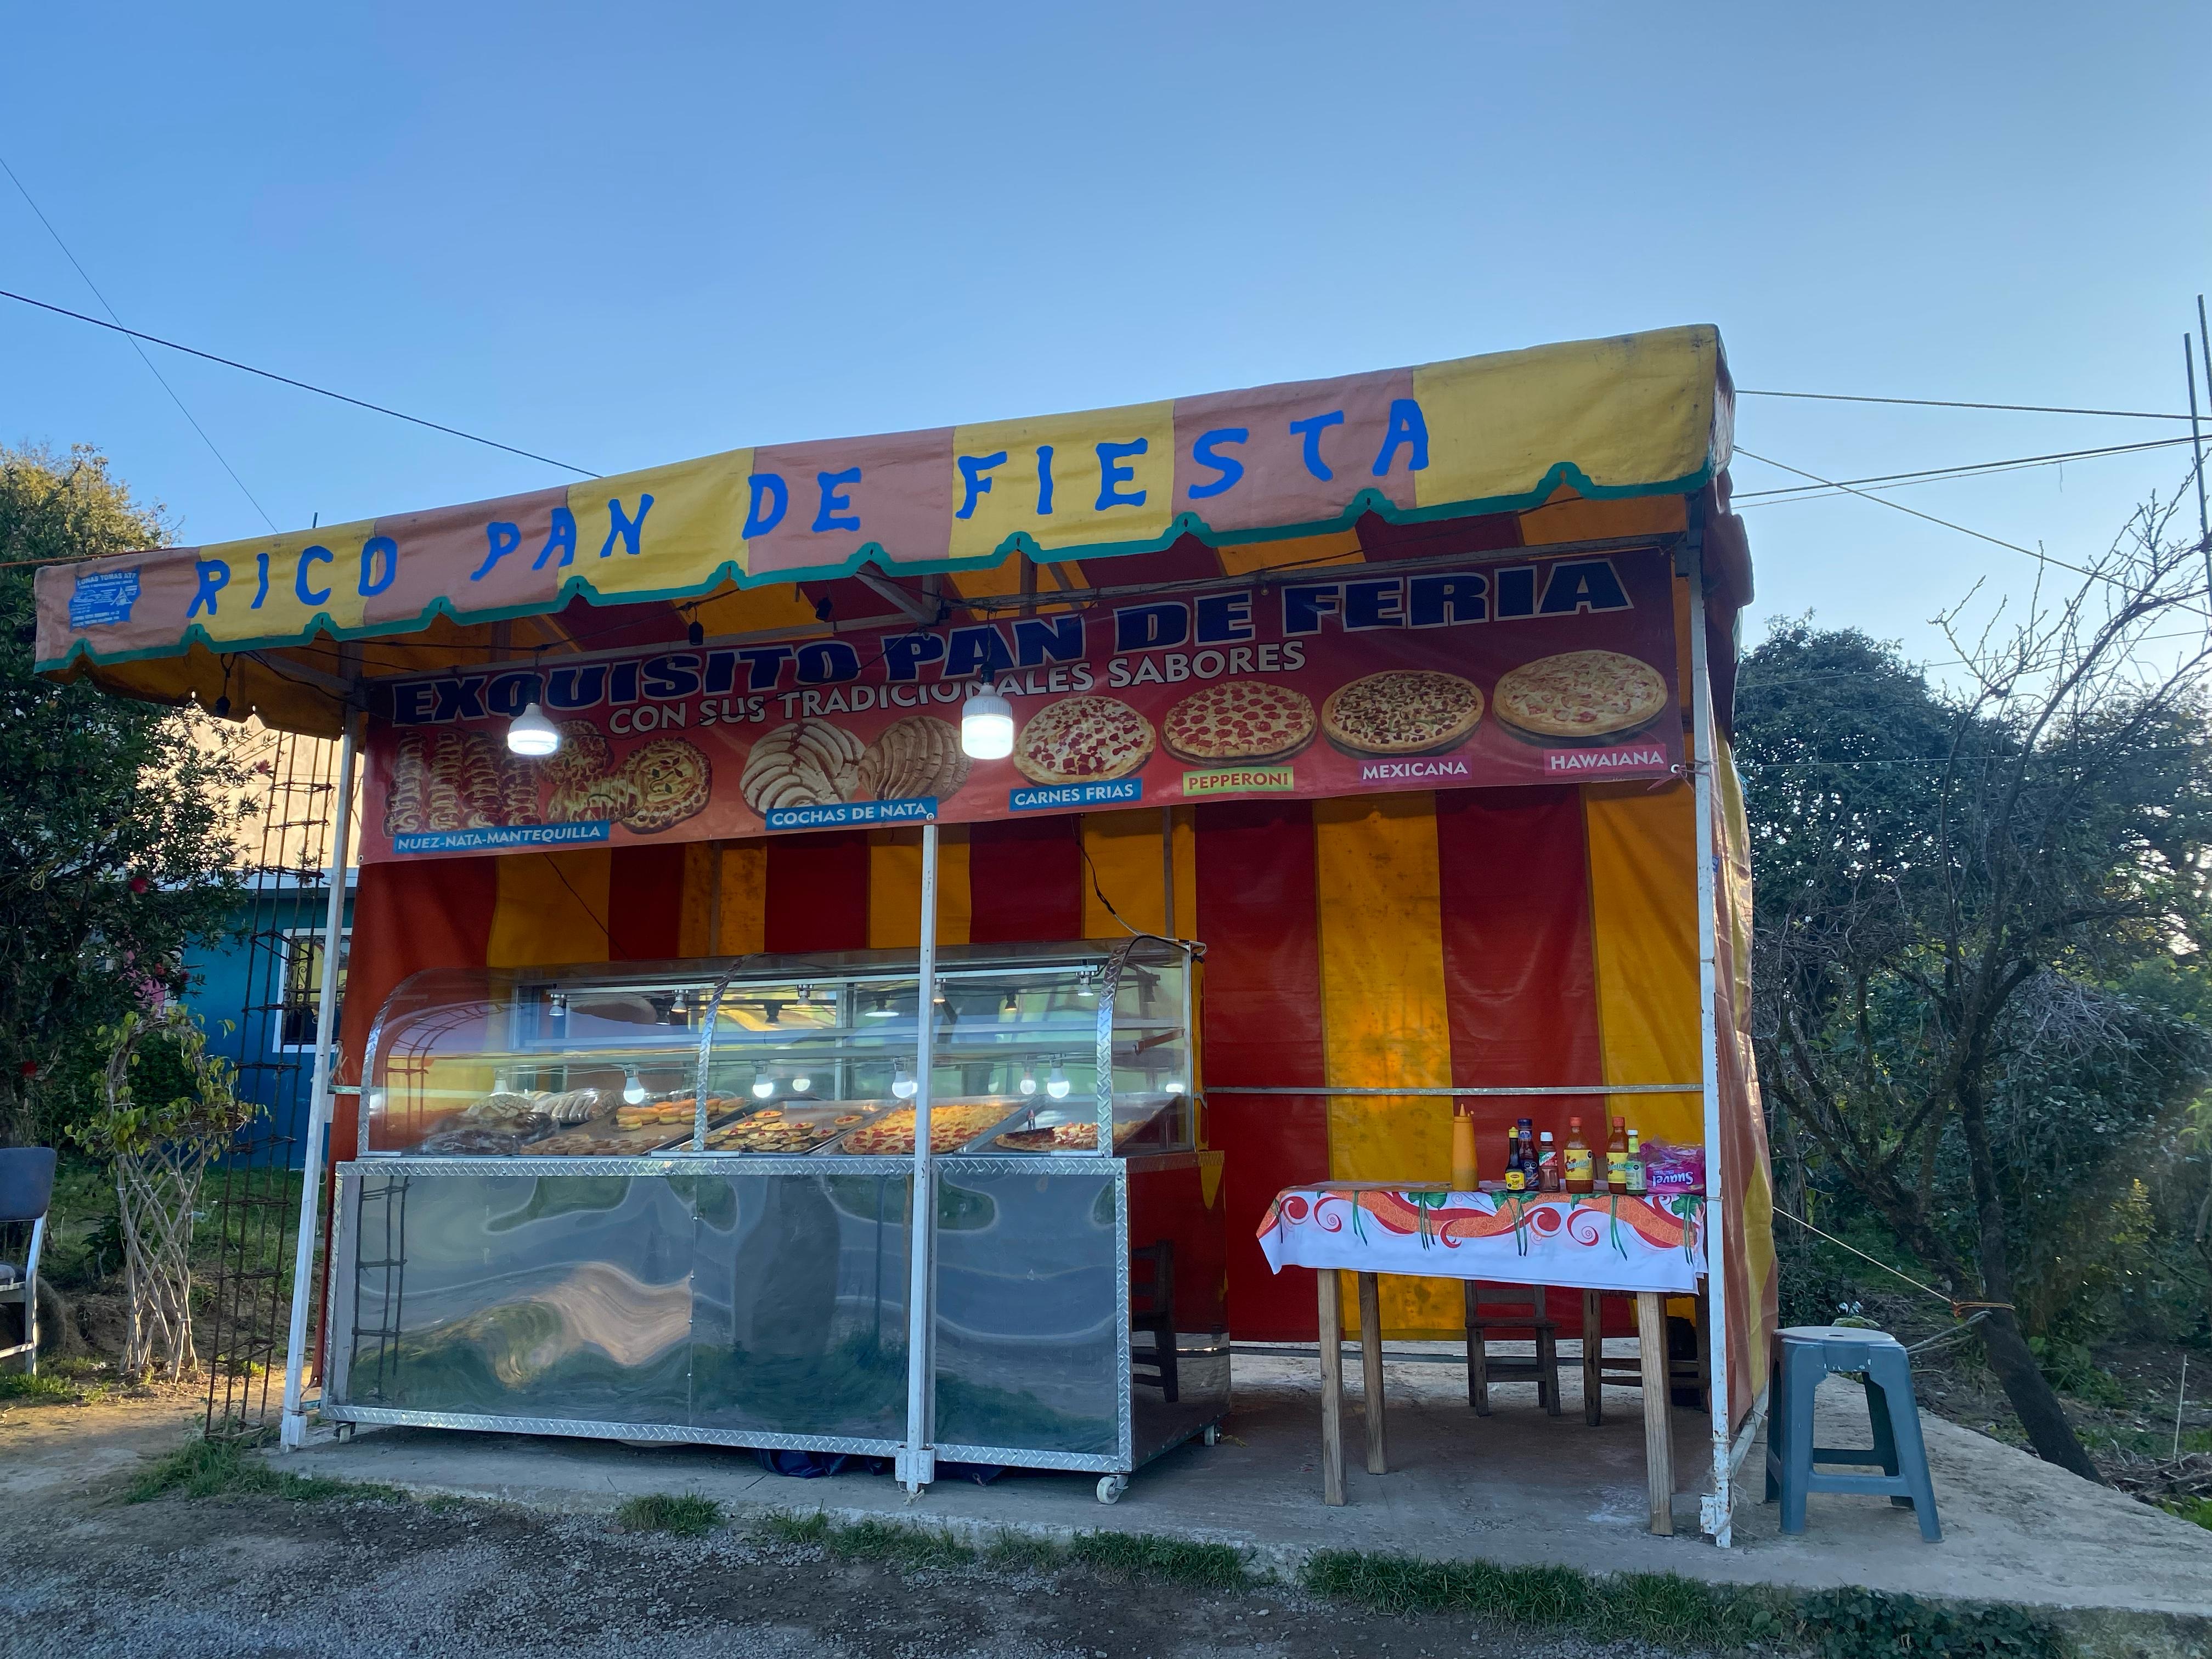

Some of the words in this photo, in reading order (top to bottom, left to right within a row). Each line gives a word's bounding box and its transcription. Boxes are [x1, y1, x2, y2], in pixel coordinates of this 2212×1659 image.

[187, 536, 398, 618] RICO
[470, 493, 654, 582] PAN
[741, 467, 862, 540] DE
[956, 399, 1429, 520] FIESTA
[392, 640, 861, 726] EXQUISITO
[881, 614, 1086, 683] PAN
[1113, 590, 1256, 655] DE
[1281, 558, 1635, 637] FERIA
[609, 702, 686, 734] CON
[699, 694, 766, 726] SUS
[1108, 641, 1306, 688] SABORES
[1362, 760, 1469, 780] MEXICANA
[1550, 750, 1664, 771] HAWAIANA
[1188, 771, 1289, 790] PEPPERONI
[1014, 787, 1080, 805] CARNES
[1086, 783, 1134, 800] FRIAS
[772, 809, 846, 826] COCHAS
[851, 806, 874, 821] DE
[880, 802, 928, 817] NATA
[398, 826, 601, 851] NUEZ-NATA-MANTEQUILLA
[1652, 1171, 1693, 1187] Suavel
